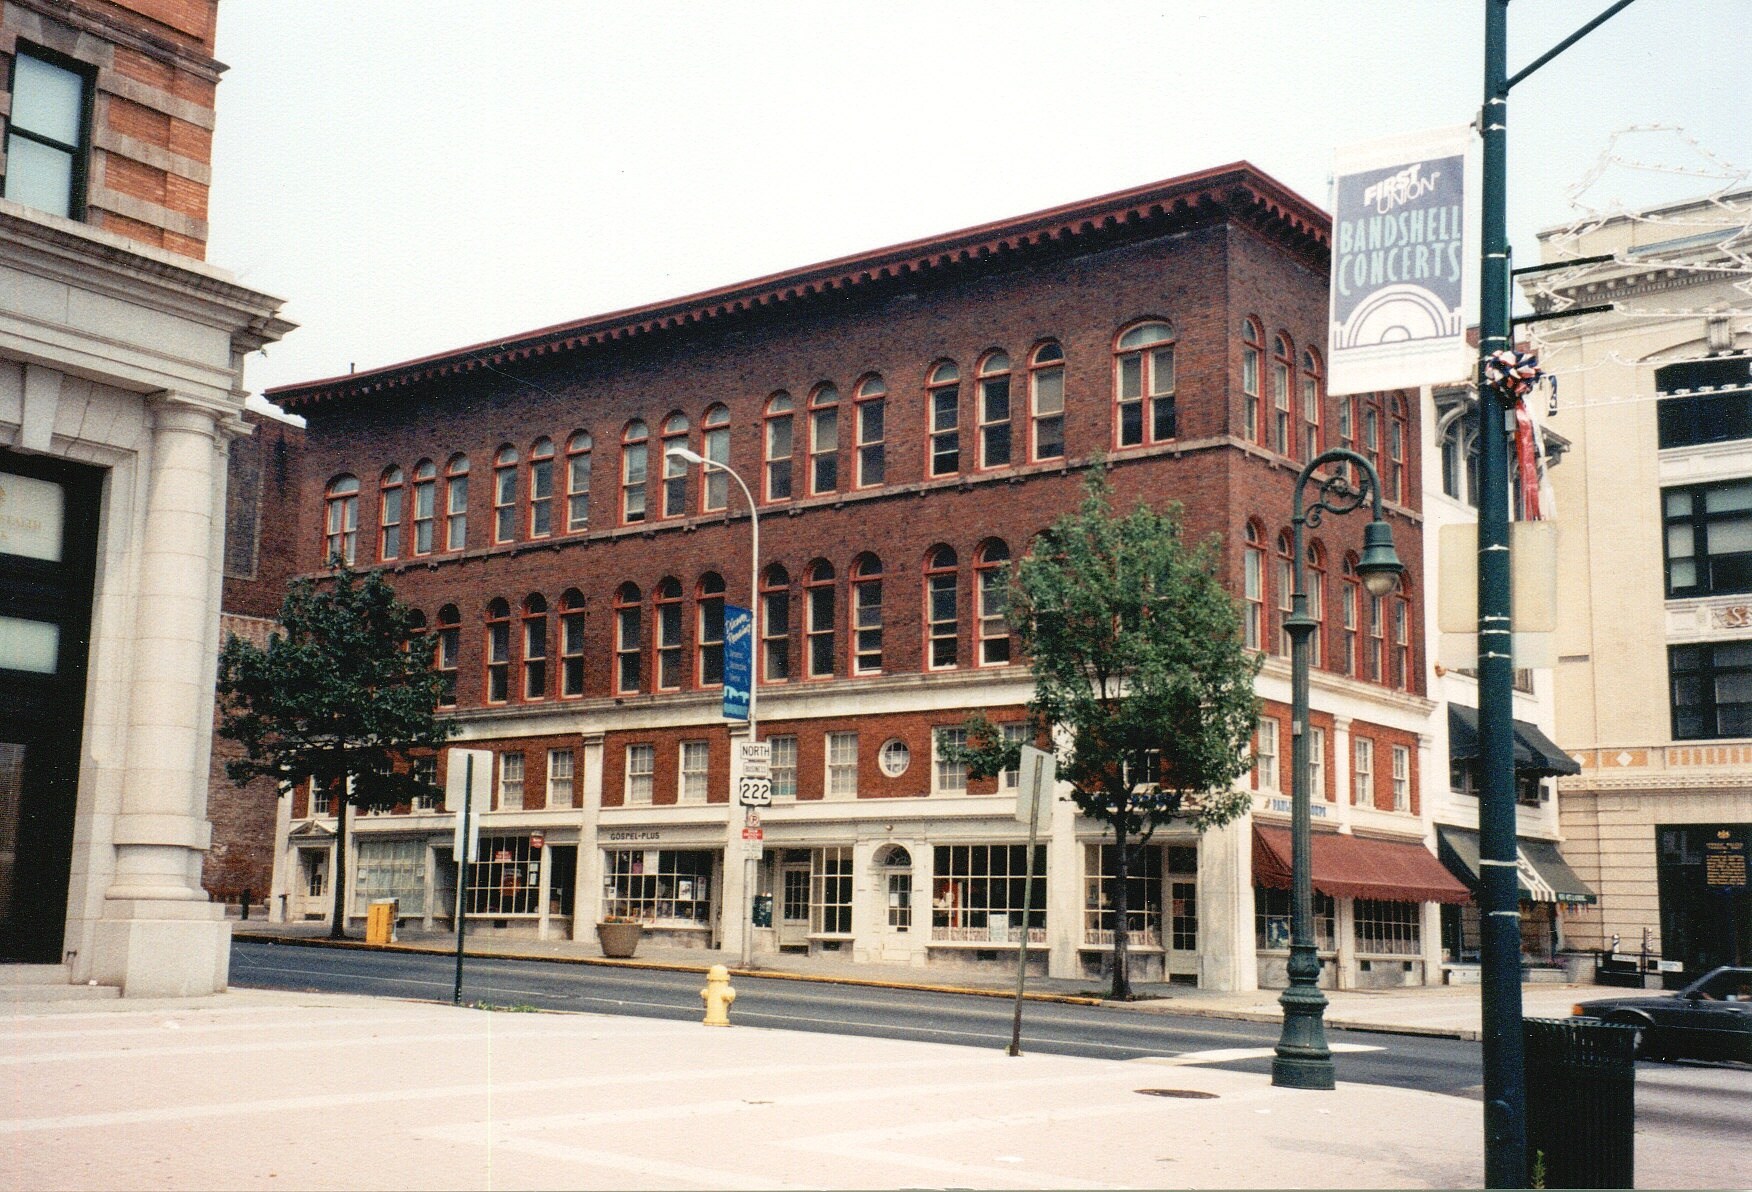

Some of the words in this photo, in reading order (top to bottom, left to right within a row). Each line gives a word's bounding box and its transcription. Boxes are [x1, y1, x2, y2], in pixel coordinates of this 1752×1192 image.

[1363, 163, 1422, 207] FIRST
[1377, 172, 1435, 214] UNION
[1339, 205, 1461, 253] BANDSHELL
[1338, 241, 1461, 296] CONCERTS
[742, 745, 770, 757] NORTH
[742, 783, 769, 800] 222
[610, 832, 660, 840] GOSPEL-PLUS
